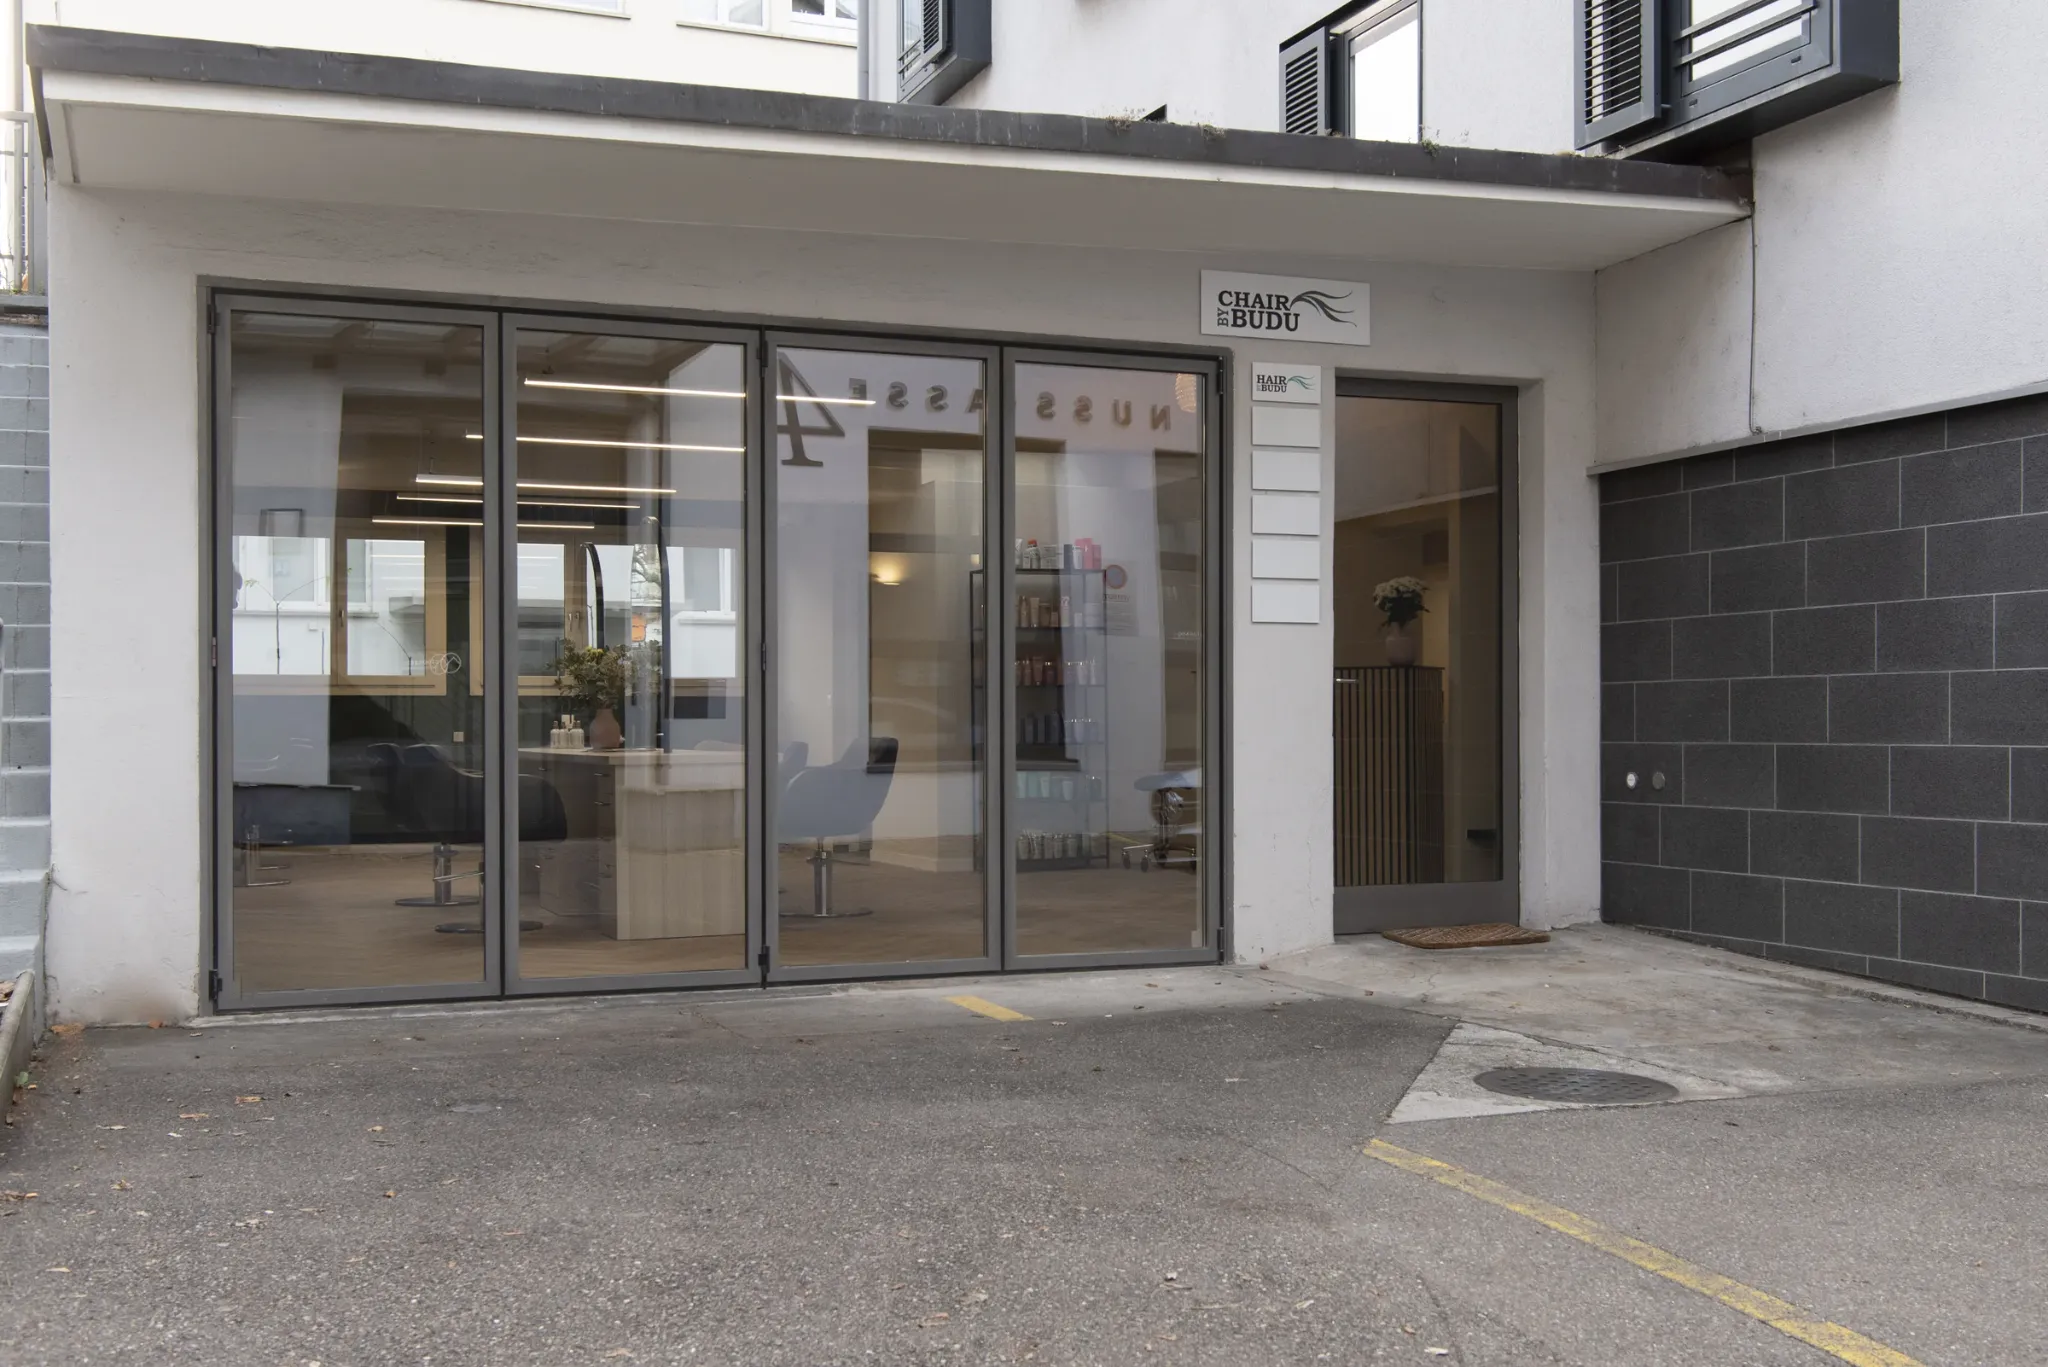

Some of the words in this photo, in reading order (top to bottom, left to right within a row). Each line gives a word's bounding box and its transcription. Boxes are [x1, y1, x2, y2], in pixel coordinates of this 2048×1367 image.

[1218, 290, 1291, 311] CHAIR
[1217, 307, 1228, 327] BY
[1231, 308, 1300, 331] BUDU
[1256, 374, 1287, 385] HAIR
[1261, 384, 1287, 393] BUDU
